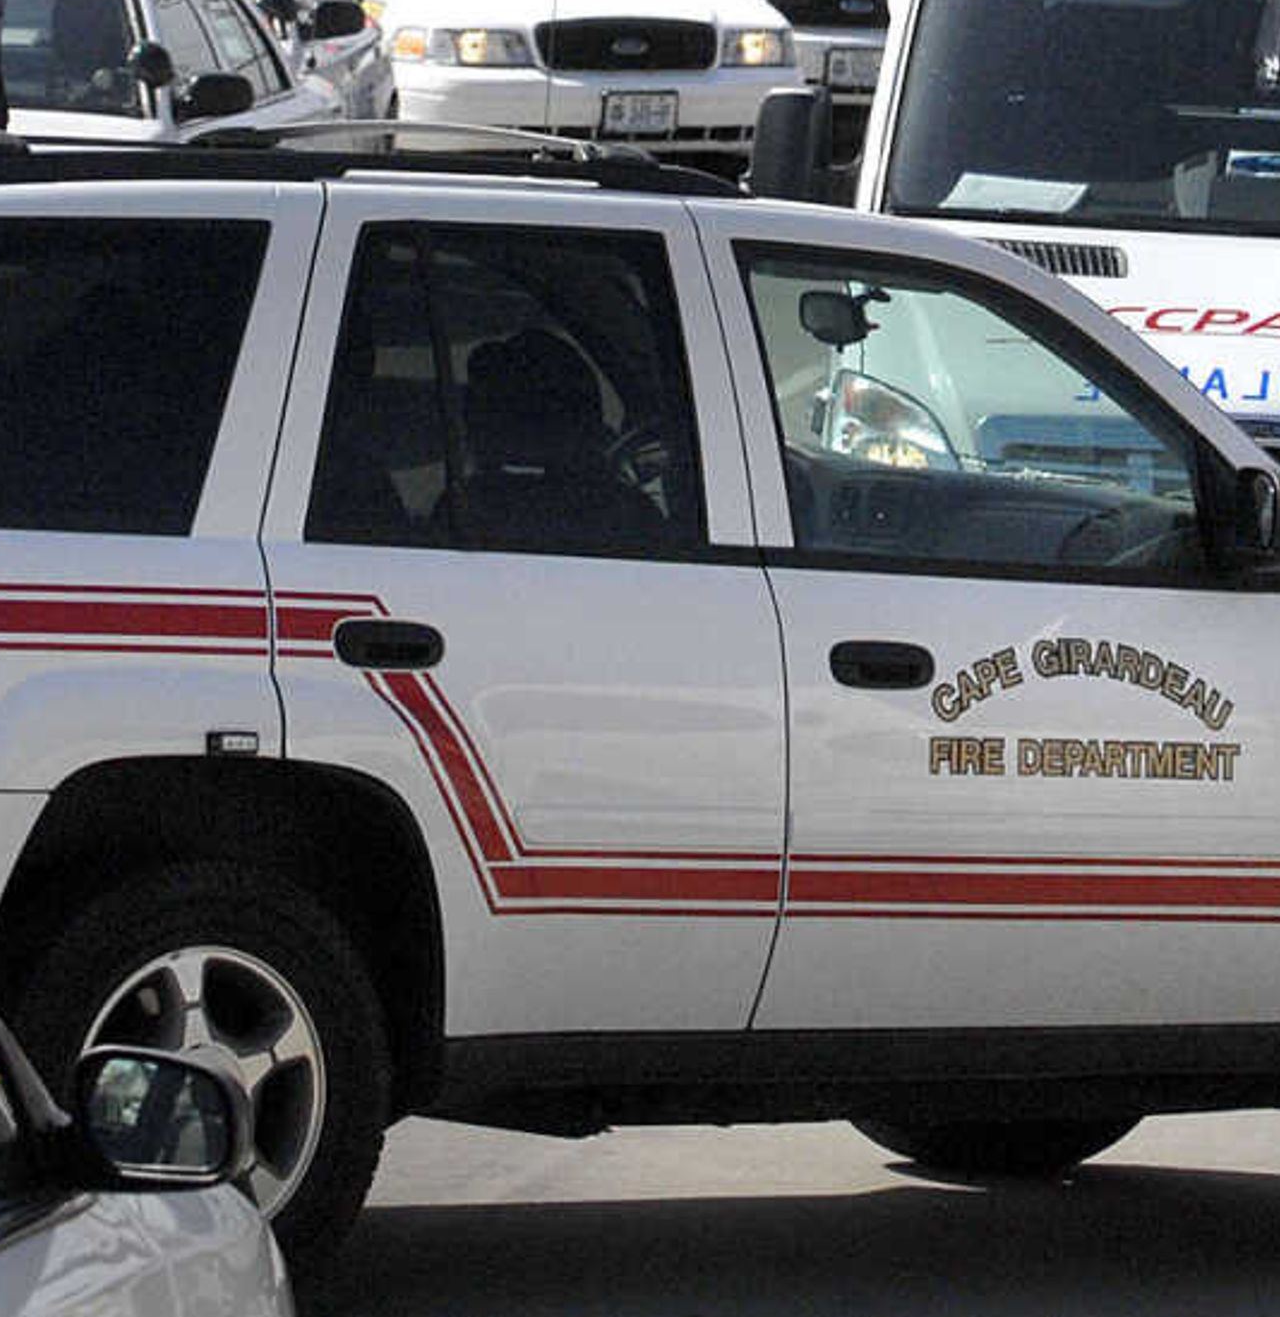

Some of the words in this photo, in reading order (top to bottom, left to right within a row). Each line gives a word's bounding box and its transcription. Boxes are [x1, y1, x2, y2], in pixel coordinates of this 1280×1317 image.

[931, 648, 1023, 722] CAPE
[1031, 637, 1234, 731] GIRARDEAU
[929, 736, 1006, 776] FIRE
[1017, 738, 1241, 781] DEPARTMENT
